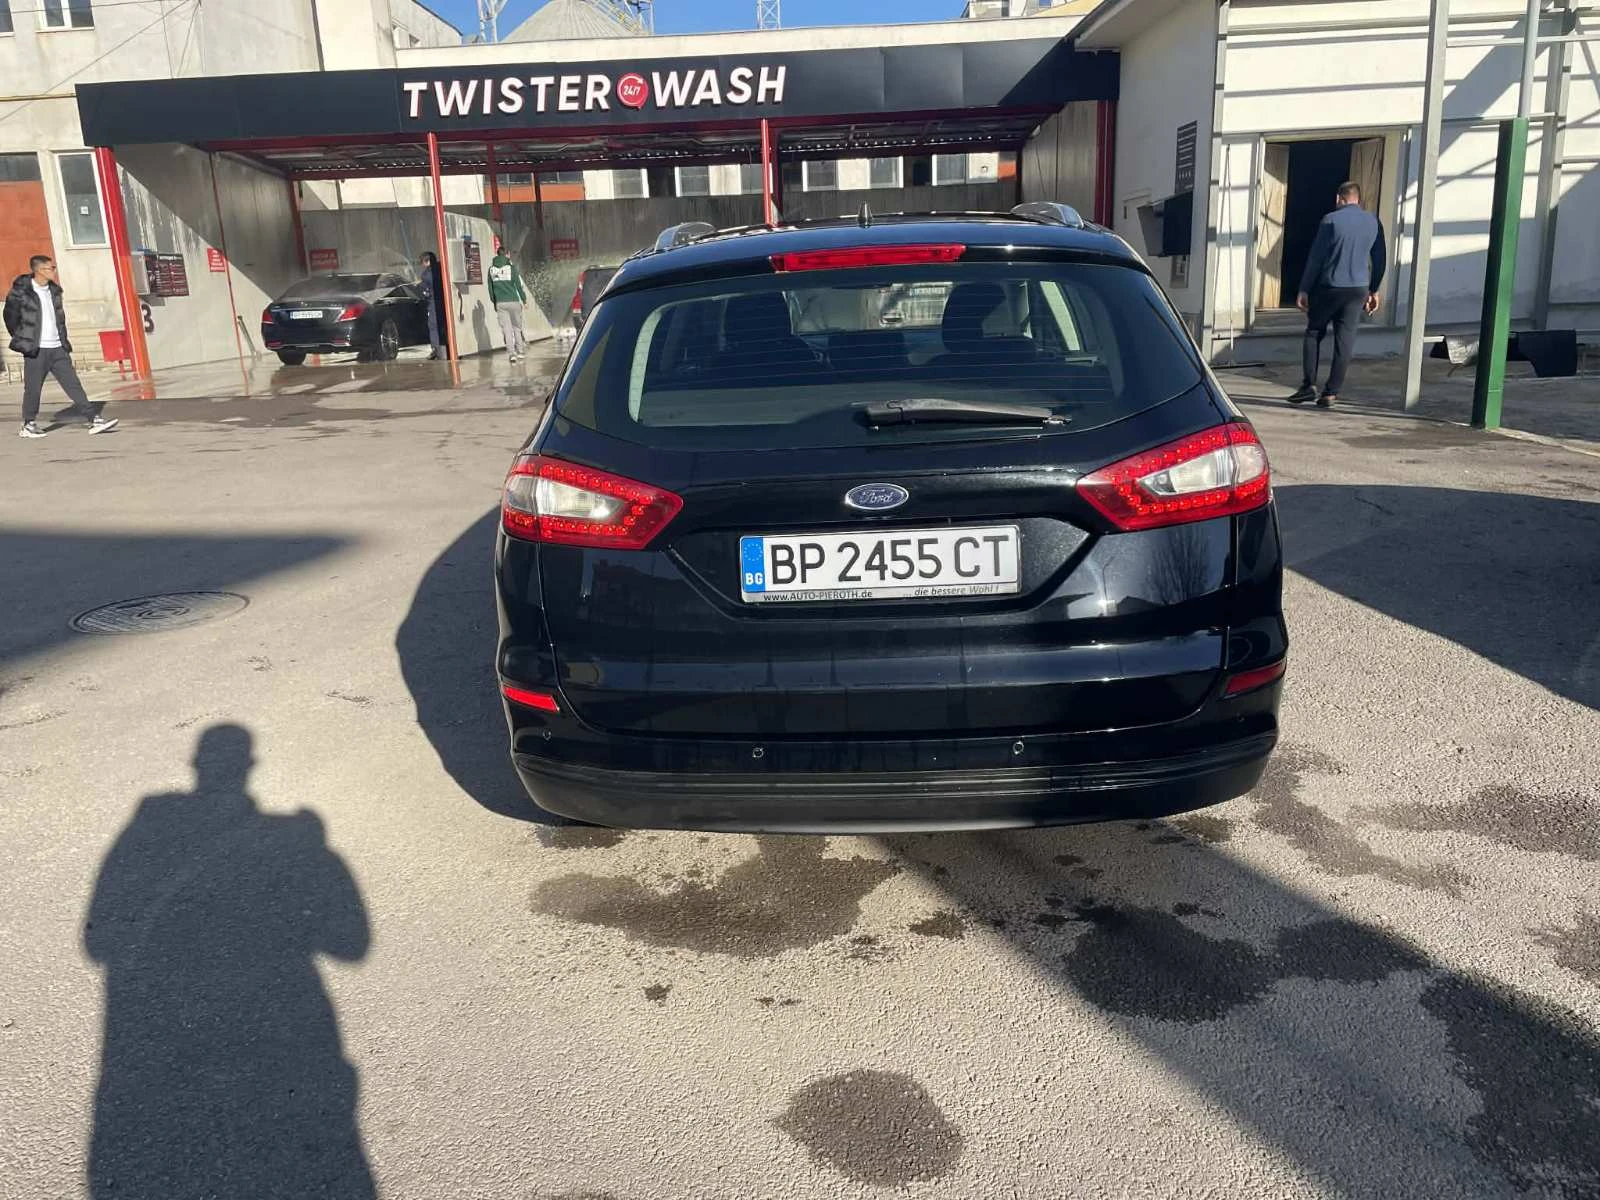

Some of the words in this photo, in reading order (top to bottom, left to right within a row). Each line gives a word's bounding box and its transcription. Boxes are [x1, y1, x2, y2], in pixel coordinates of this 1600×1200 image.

[403, 74, 612, 118] TWISTER
[623, 85, 641, 96] 24/7
[651, 65, 787, 108] WASH
[859, 488, 894, 504] Ford
[770, 542, 826, 586] BP
[837, 536, 943, 583] 2455
[953, 533, 1010, 578] CT
[745, 572, 764, 585] BG
[763, 589, 873, 602] www.AUTO-PIEROTH.de
[930, 586, 967, 596] bessere
